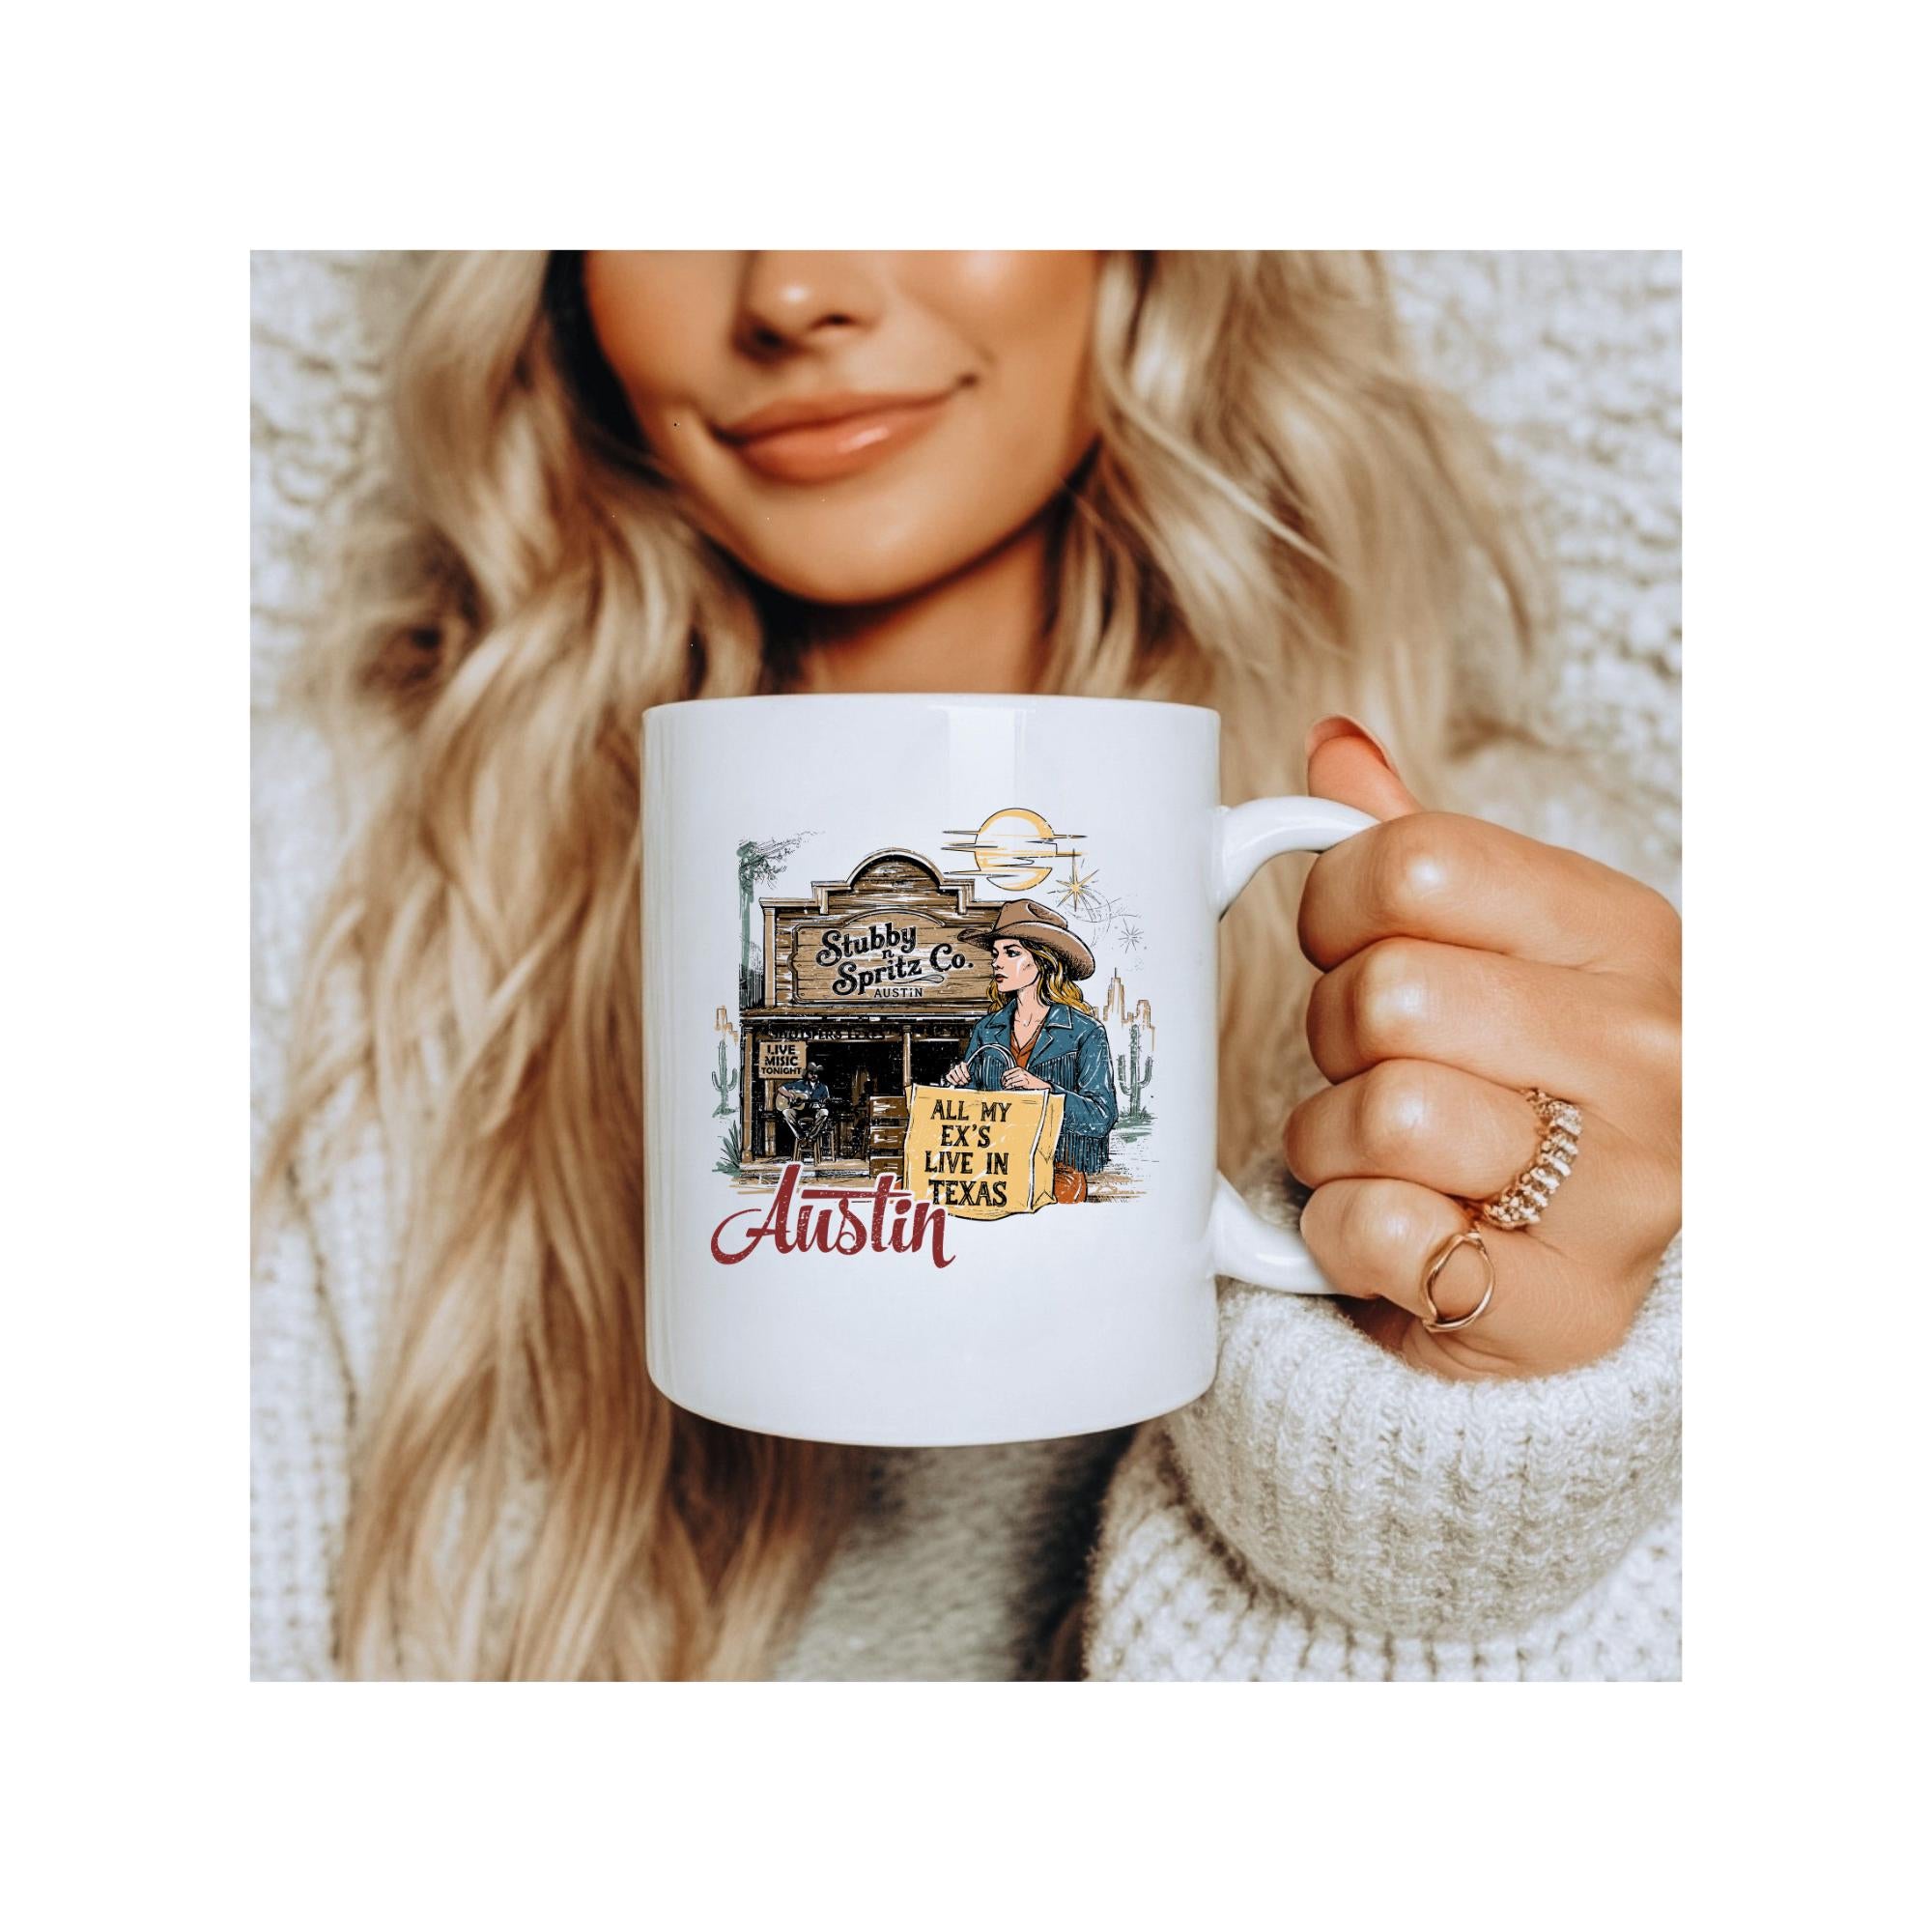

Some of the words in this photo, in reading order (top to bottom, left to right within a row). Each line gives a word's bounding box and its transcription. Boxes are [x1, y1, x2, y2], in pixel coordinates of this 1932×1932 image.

[816, 922, 917, 966] Stubby
[882, 949, 895, 959] n
[832, 955, 923, 996] Spritz
[929, 943, 974, 972] Co.
[764, 1056, 798, 1066] MISIC
[767, 1044, 796, 1055] LIVE
[930, 1099, 970, 1121] ALL
[980, 1101, 1012, 1122] MY
[940, 1124, 991, 1148] EX'S
[924, 1151, 974, 1174] LIVE
[985, 1152, 1009, 1175] IN
[928, 1179, 1008, 1208] TEXAS
[710, 1164, 956, 1268] Austin
